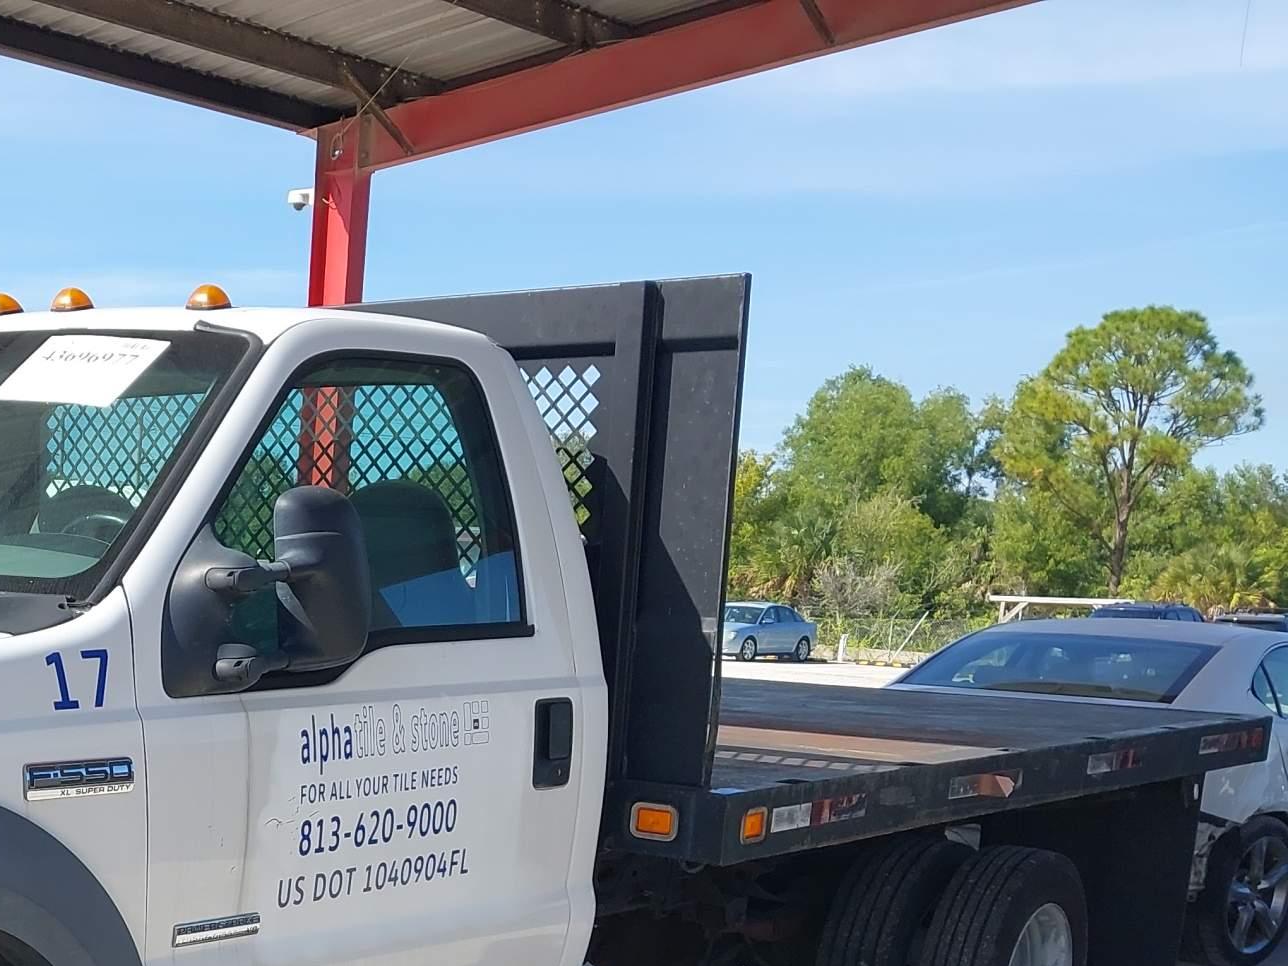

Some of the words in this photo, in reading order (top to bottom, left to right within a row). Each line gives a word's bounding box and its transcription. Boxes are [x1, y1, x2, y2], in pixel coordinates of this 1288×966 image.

[45, 649, 108, 710] 17
[392, 703, 405, 754] &
[411, 708, 460, 753] stone
[60, 789, 71, 797] XL
[75, 786, 105, 795] SUPER
[107, 784, 131, 793] DUTY
[300, 784, 326, 805] FOR
[330, 780, 352, 801] ALL
[356, 775, 390, 797] YOUR
[393, 771, 417, 792] TILE
[421, 765, 459, 788] NEEDS
[299, 799, 457, 856] 813-620-9000
[277, 876, 305, 908] US
[313, 867, 357, 902] DOT
[362, 848, 469, 893] 1040904FL
